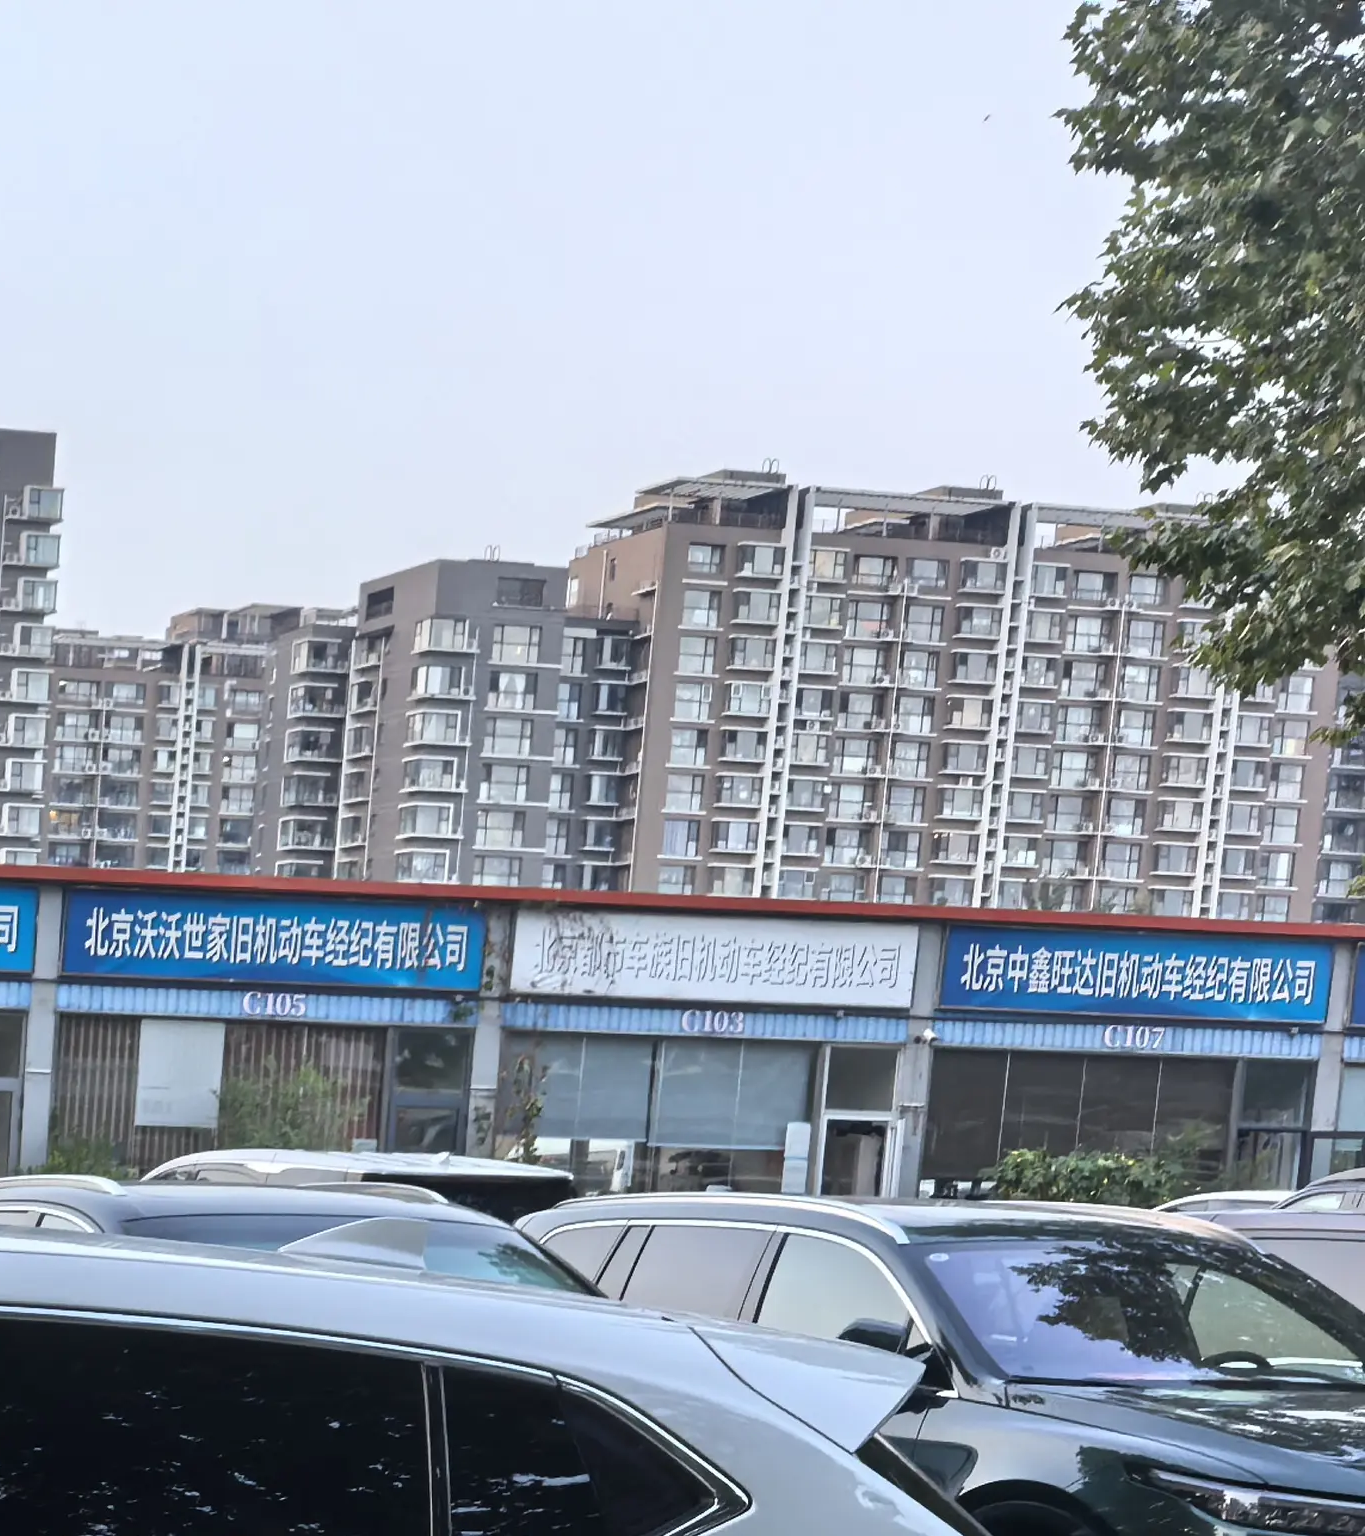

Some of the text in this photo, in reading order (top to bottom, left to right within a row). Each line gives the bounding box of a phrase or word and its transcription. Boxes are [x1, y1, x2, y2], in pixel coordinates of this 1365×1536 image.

[84, 906, 469, 971] 北京沃沃世家旧机动车经纪有限公司
[960, 943, 1316, 1005] 北京中鑫旺达旧机动车经纪有限公司
[242, 991, 307, 1017] C105
[681, 1009, 745, 1034] C103
[1104, 1024, 1166, 1049] C107
